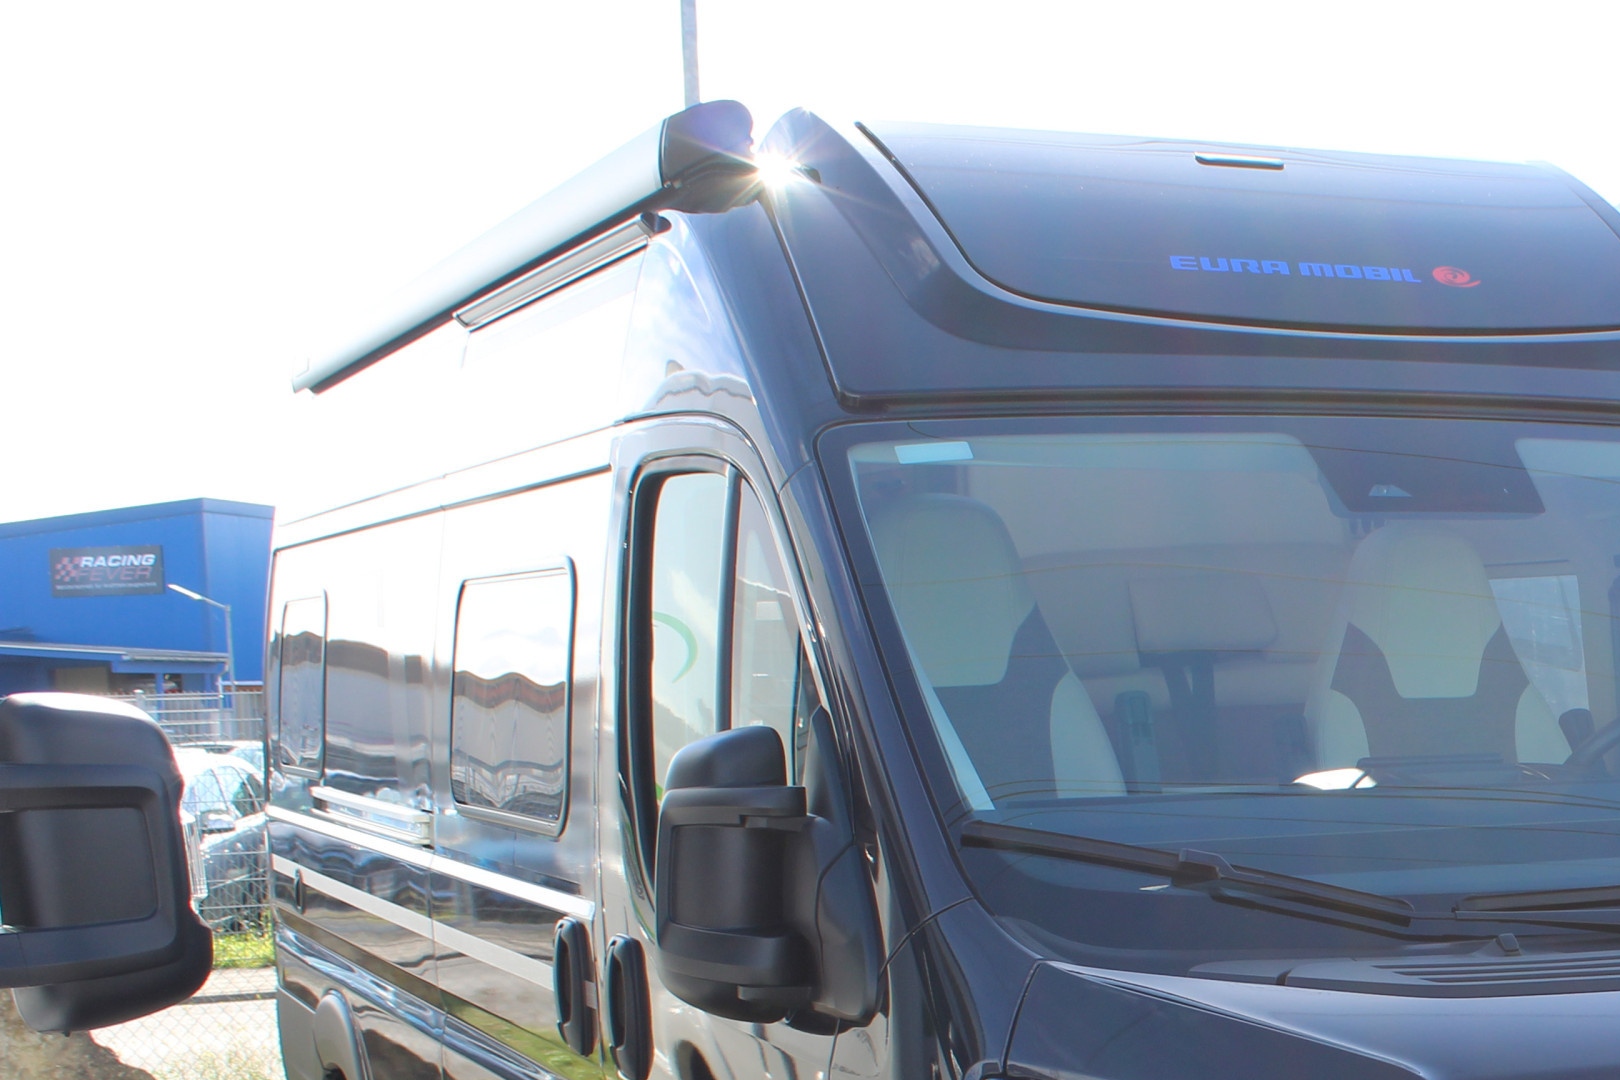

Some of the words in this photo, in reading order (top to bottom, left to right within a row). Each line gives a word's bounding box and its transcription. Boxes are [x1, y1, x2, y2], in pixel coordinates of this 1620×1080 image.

[1170, 255, 1290, 275] EURA
[1298, 262, 1422, 283] MOBIL
[81, 553, 156, 568] RACING
[74, 565, 151, 582] FEVER
